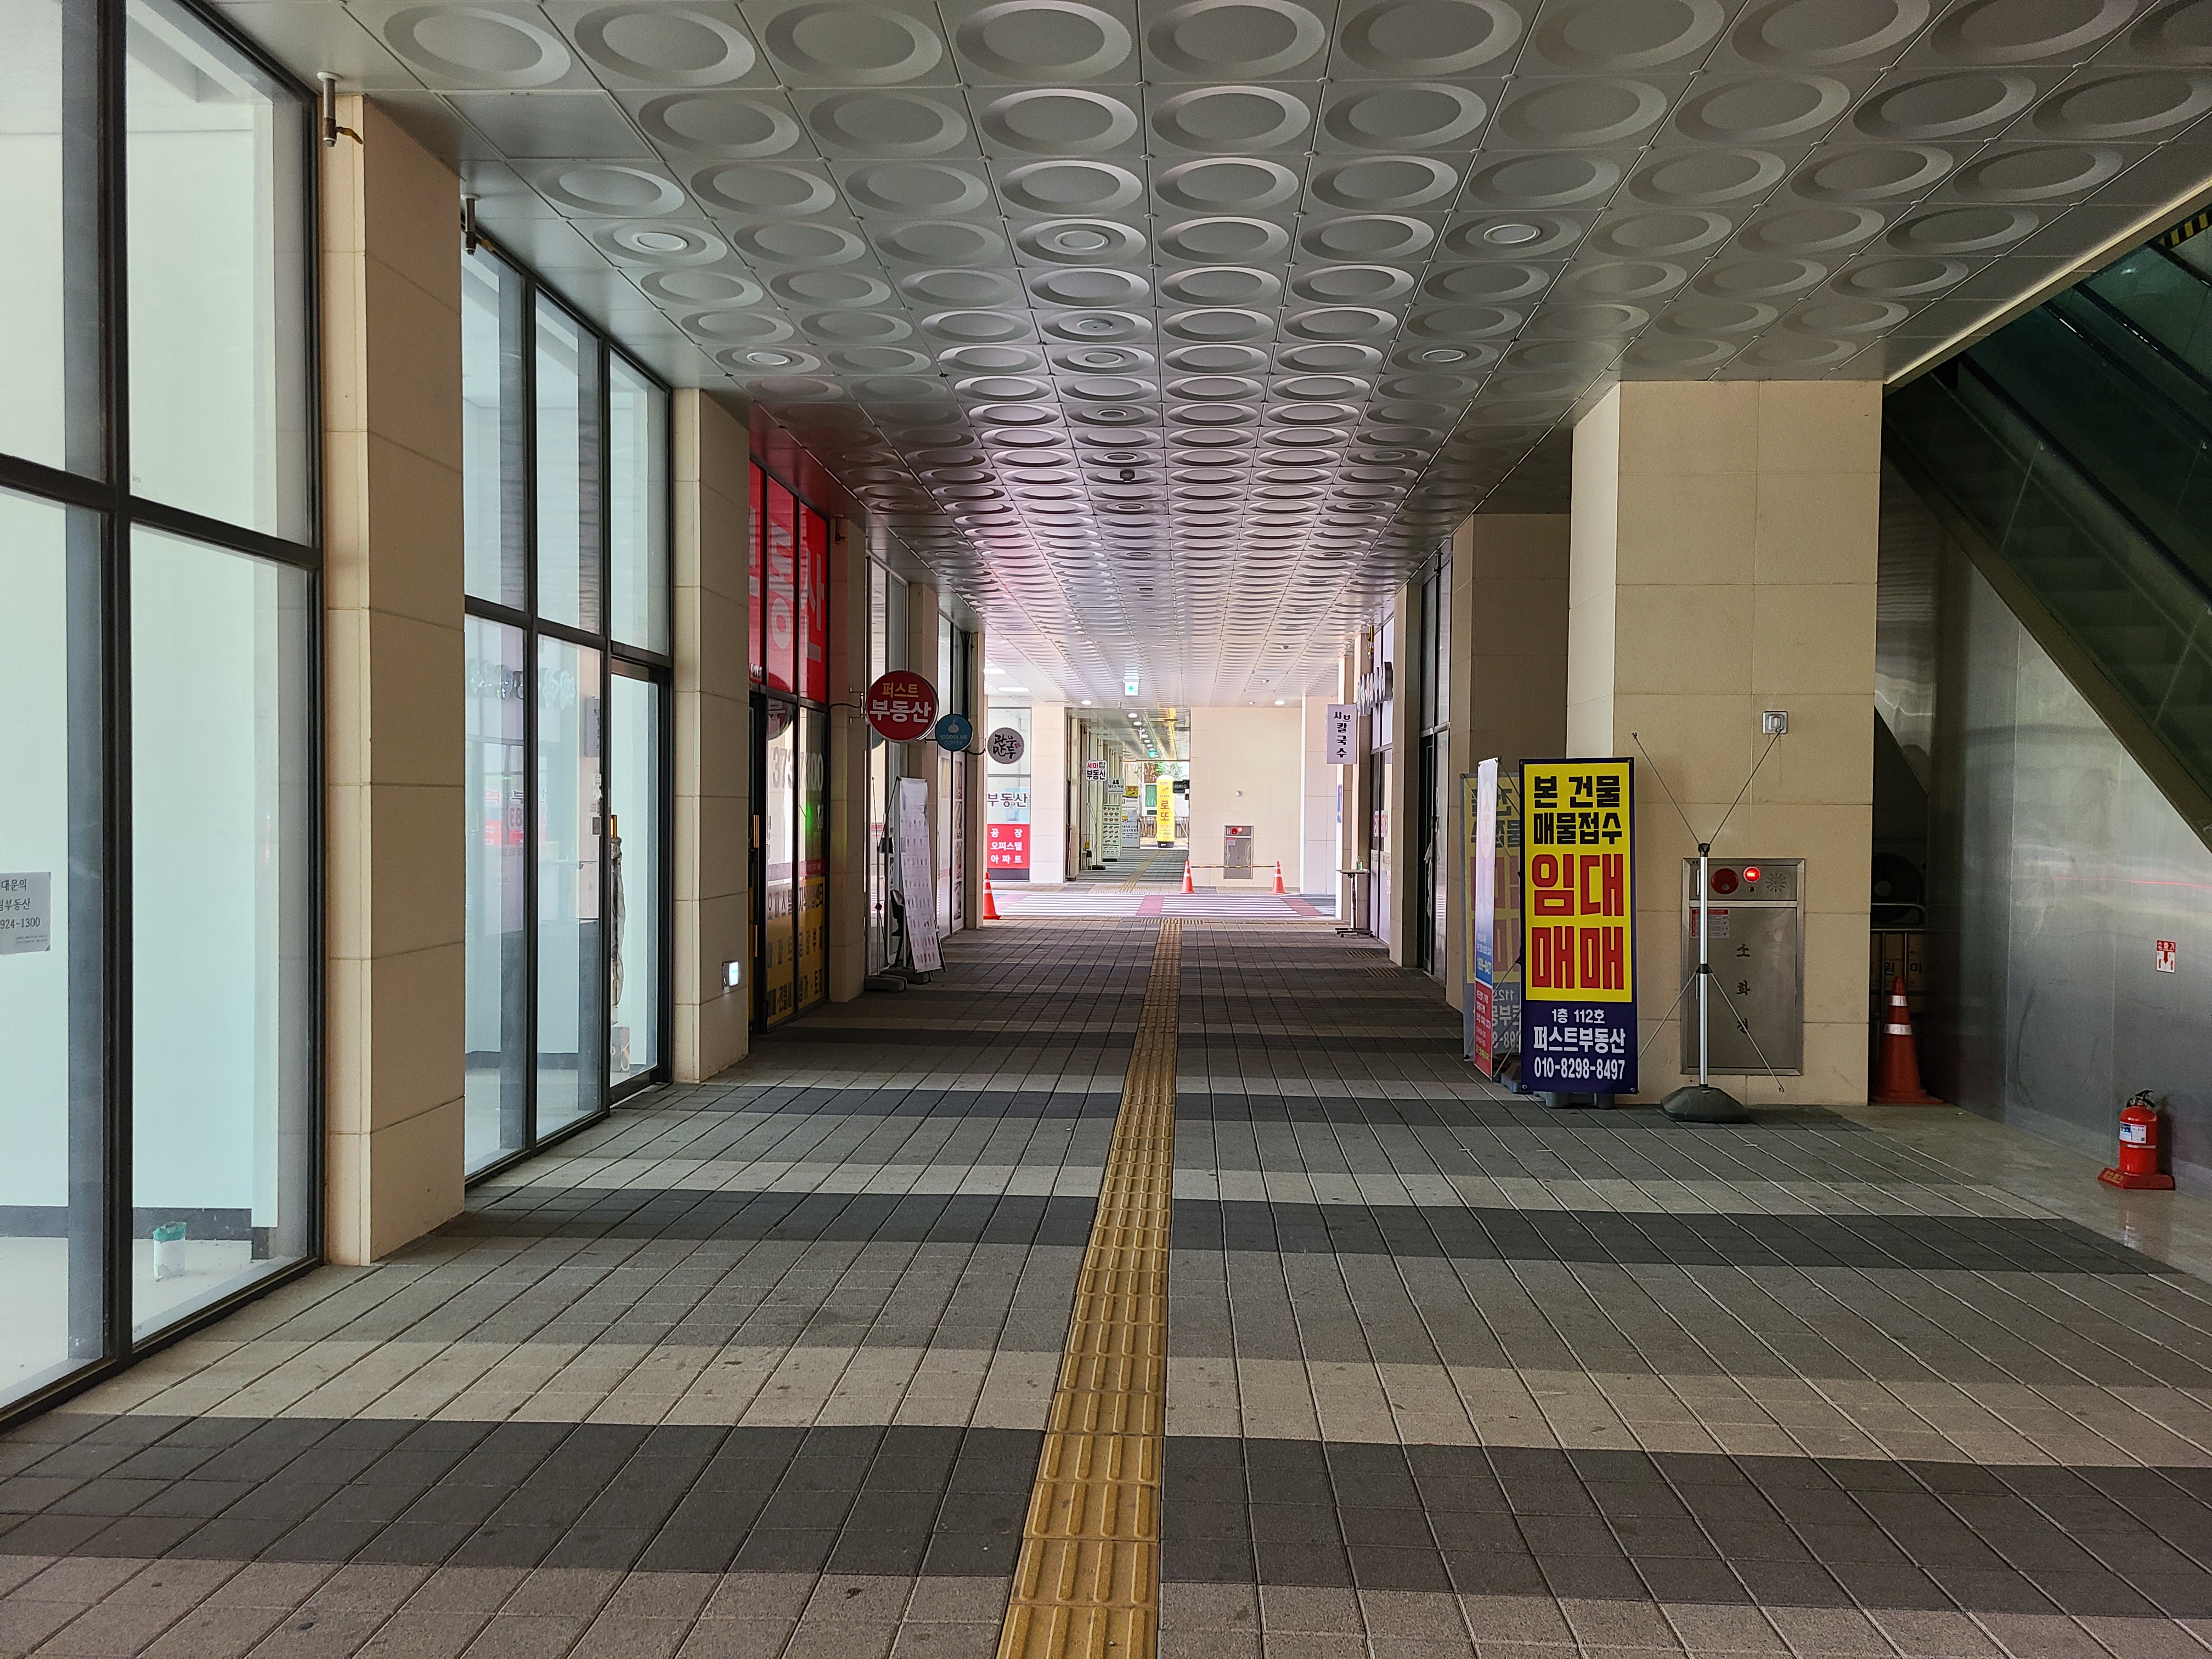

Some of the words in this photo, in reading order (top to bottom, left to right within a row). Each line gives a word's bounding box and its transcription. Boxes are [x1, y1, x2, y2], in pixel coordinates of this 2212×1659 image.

[882, 682, 919, 698] 퍼스트
[870, 699, 932, 723] 부동산
[1087, 770, 1106, 780] 부동산
[987, 793, 1028, 808] 부동산
[1534, 776, 1558, 808] 본
[1568, 776, 1620, 808] 건물
[1160, 800, 1170, 821] 로또
[1534, 812, 1622, 845] 매물접수
[990, 842, 1023, 851] 오피스텔
[990, 854, 1023, 864] 아파트
[1531, 853, 1623, 917] 임대
[2158, 941, 2175, 950] 소화기
[1531, 926, 1624, 990] 매매
[1551, 1008, 1567, 1024] 1층
[1574, 1009, 1605, 1024] 112호
[1534, 1026, 1626, 1053] 퍼스트부동산
[1534, 1057, 1626, 1080] 010-8298-8497
